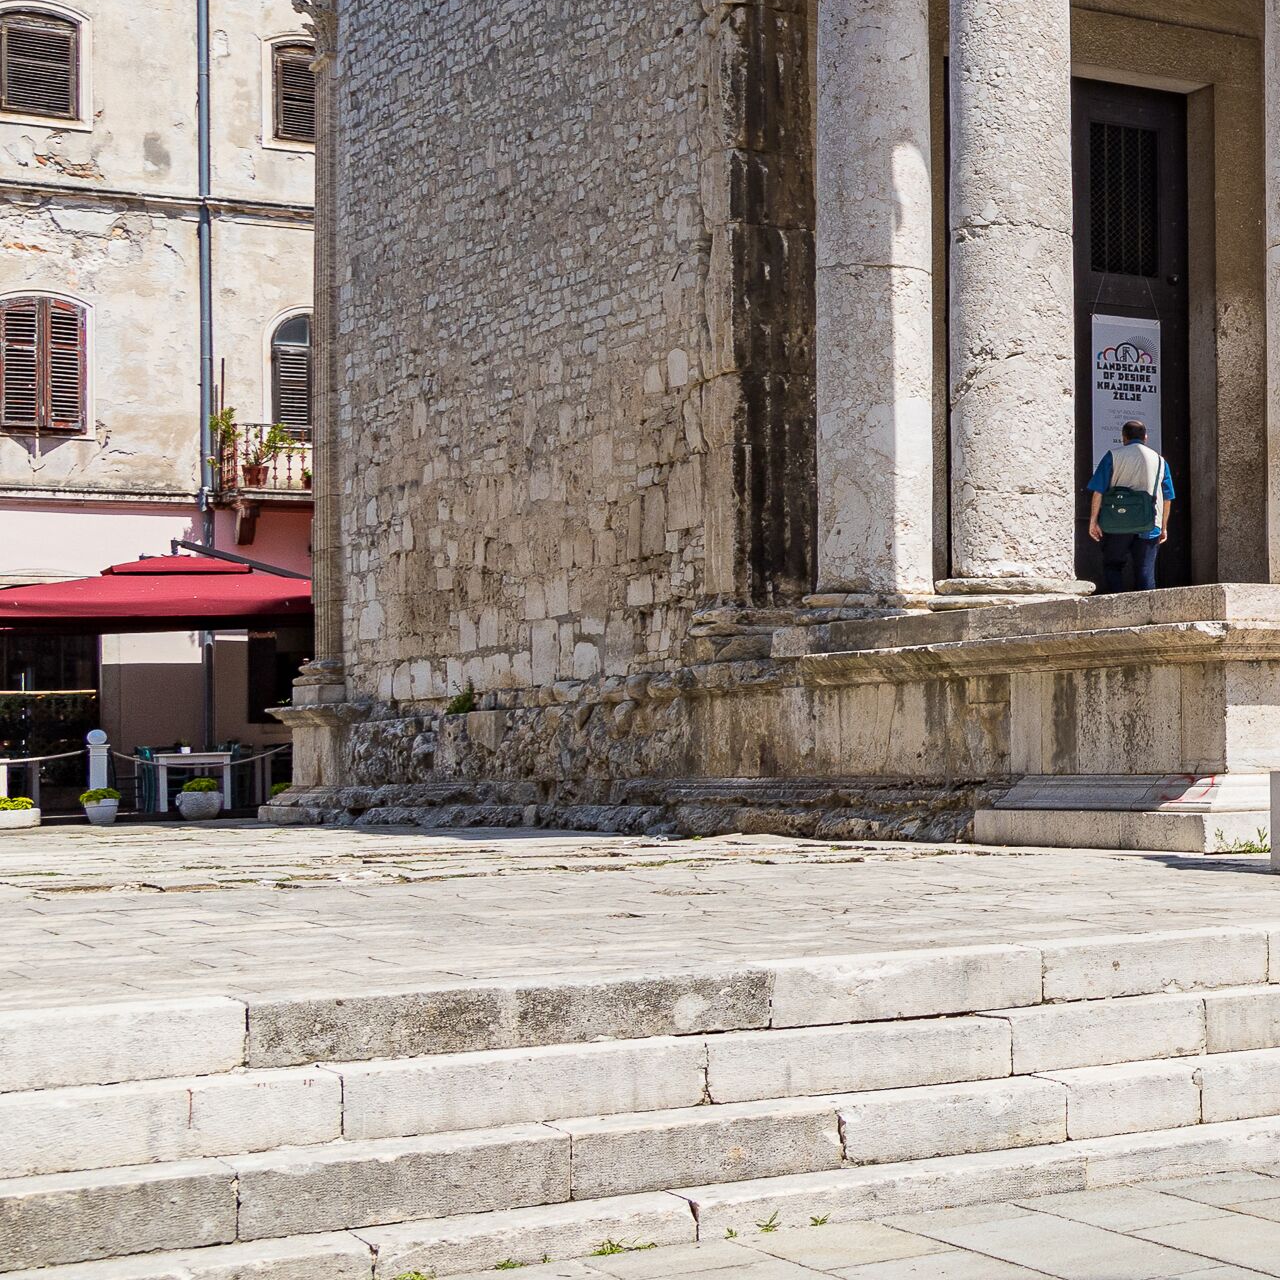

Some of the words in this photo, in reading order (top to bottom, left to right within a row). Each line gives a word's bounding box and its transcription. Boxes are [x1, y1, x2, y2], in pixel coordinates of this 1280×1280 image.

[1096, 361, 1157, 374] LANDSCAPES
[1103, 371, 1115, 380] OF
[1118, 372, 1151, 382] DESIRE
